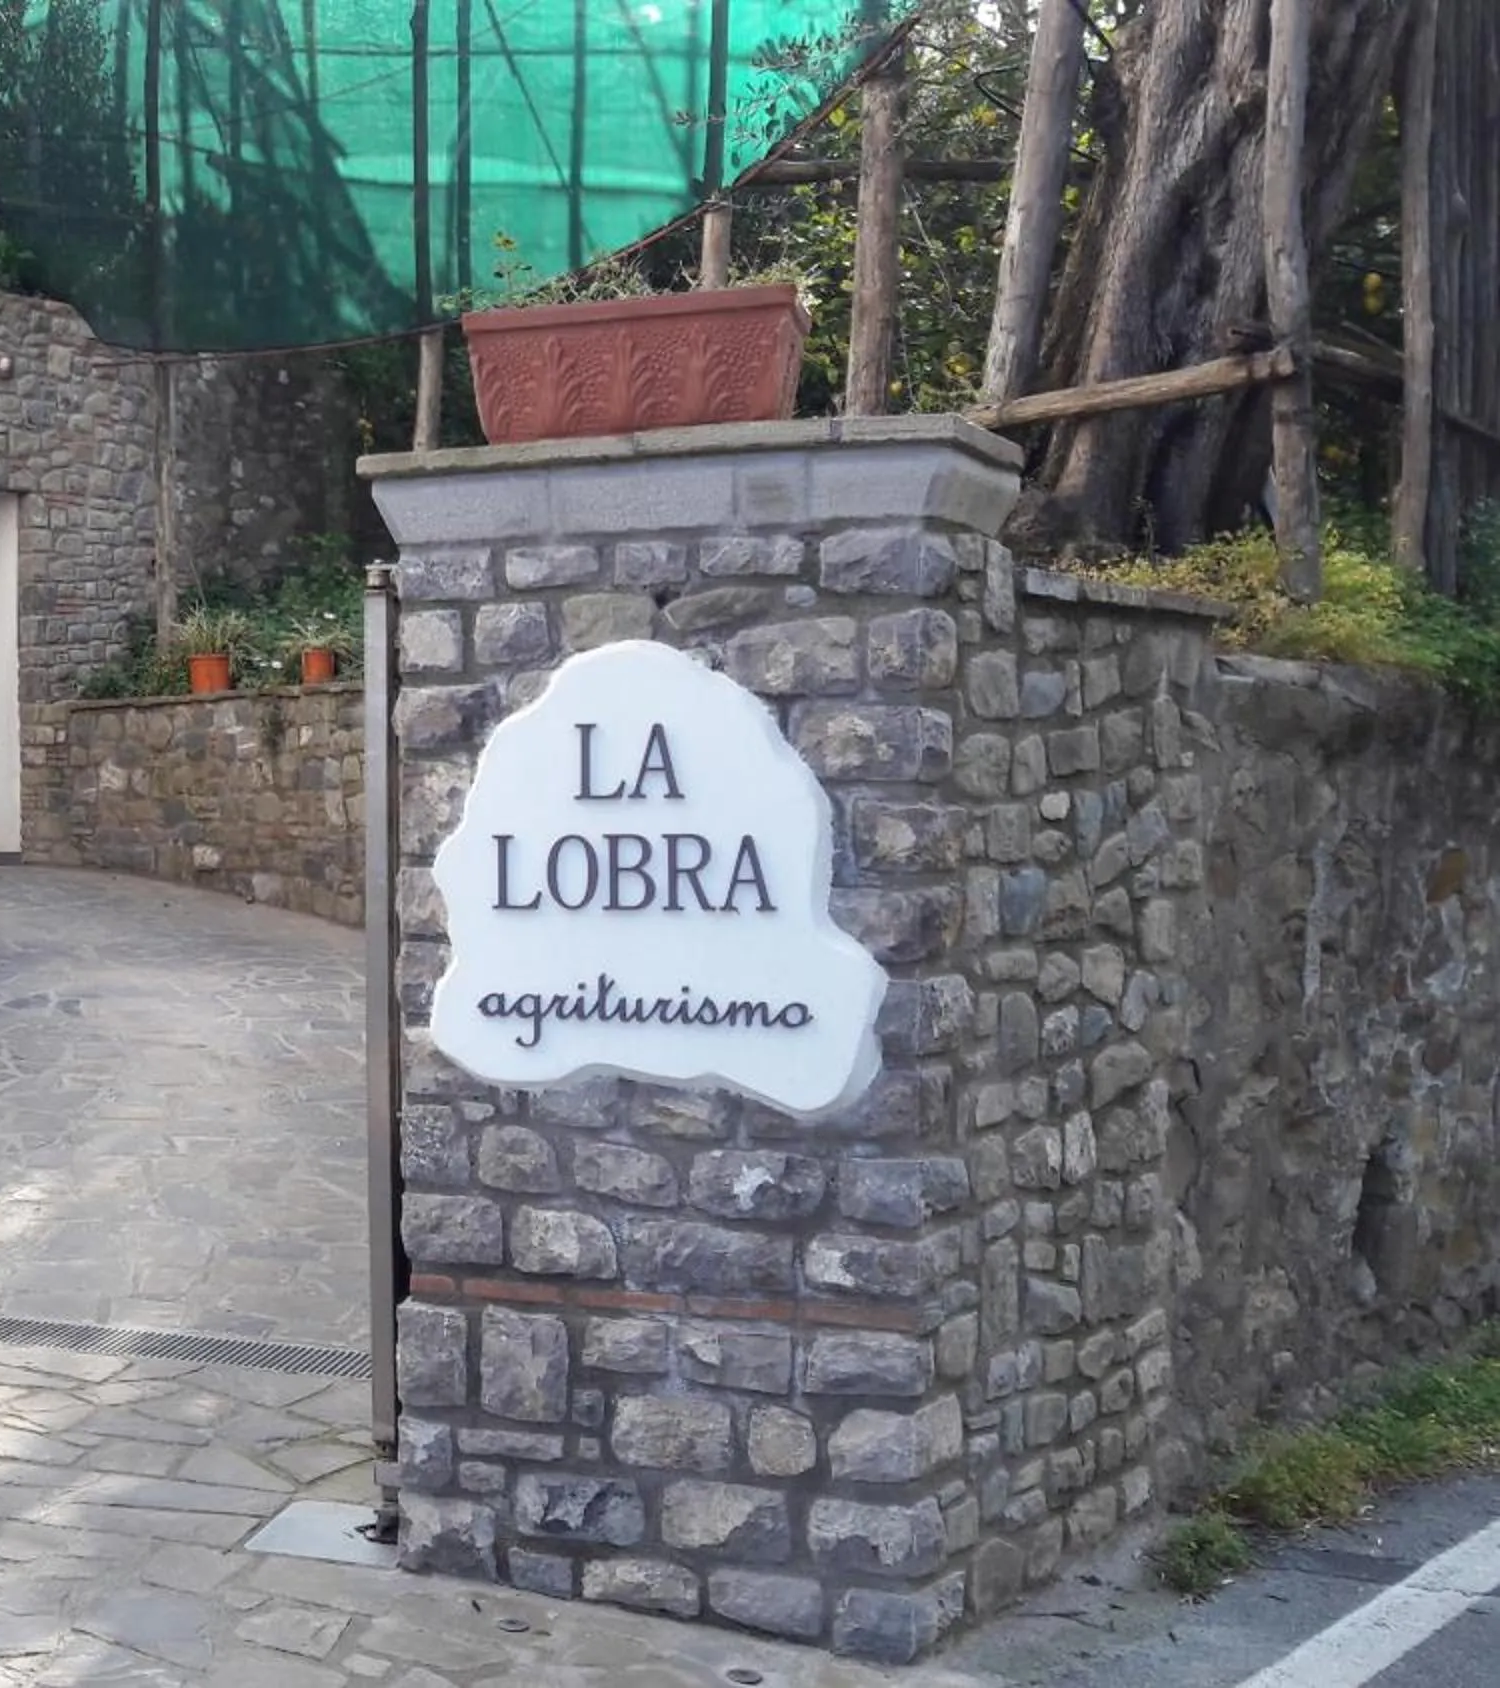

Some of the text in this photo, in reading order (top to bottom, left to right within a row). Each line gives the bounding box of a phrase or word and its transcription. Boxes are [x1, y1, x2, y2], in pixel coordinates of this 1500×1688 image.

[574, 723, 685, 800] LA
[492, 834, 778, 912] LOBRA
[477, 973, 814, 1048] agriturismo
